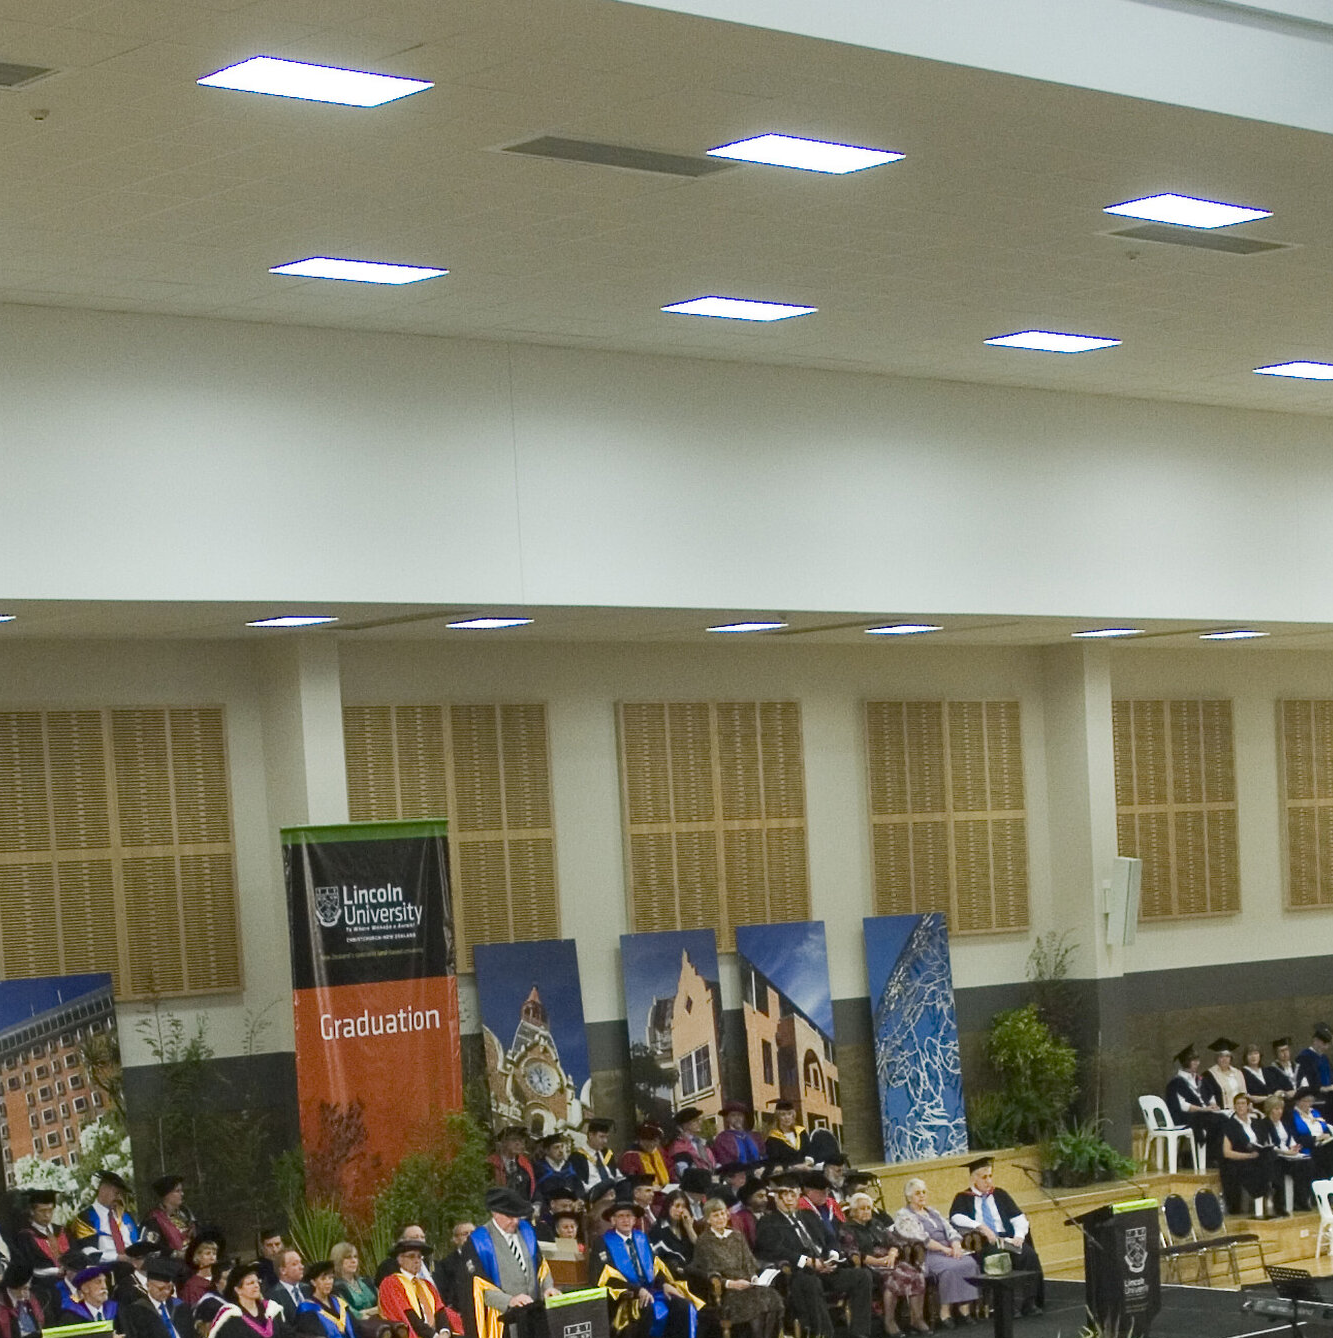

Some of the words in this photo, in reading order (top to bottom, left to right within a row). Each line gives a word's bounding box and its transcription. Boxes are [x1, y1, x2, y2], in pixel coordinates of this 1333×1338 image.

[342, 883, 403, 905] Lincoln
[343, 901, 423, 925] University
[319, 1004, 440, 1041] Graduation
